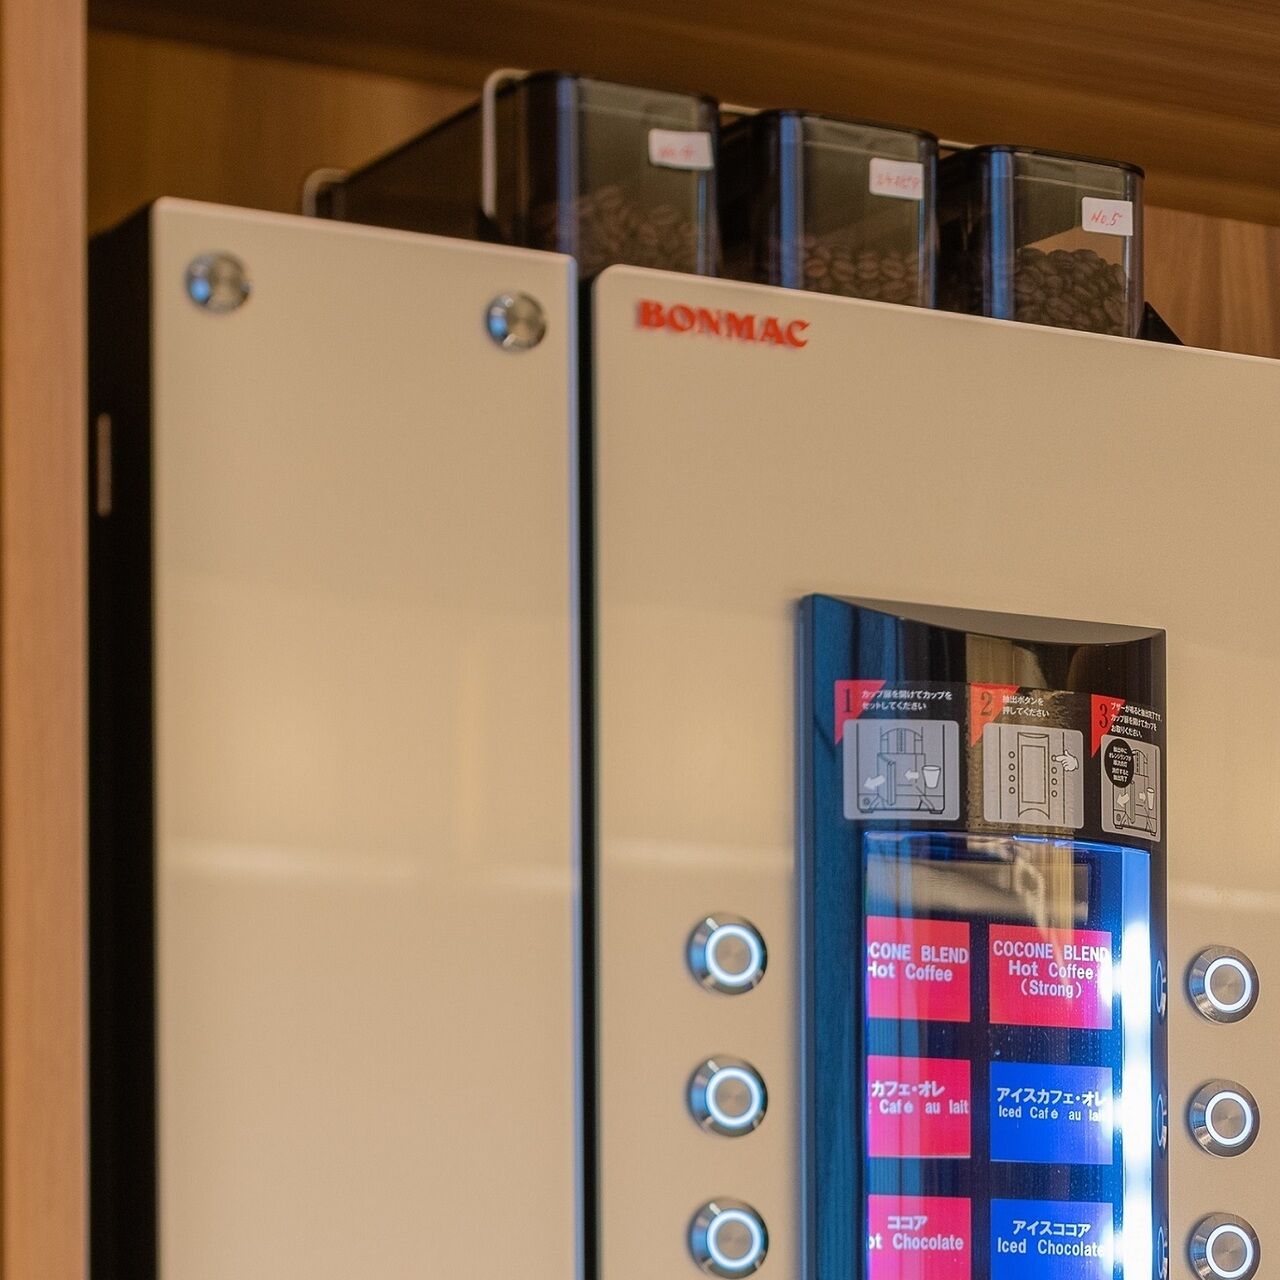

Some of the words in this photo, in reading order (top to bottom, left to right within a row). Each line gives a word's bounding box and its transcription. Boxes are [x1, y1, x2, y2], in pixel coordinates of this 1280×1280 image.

[636, 300, 810, 347] BONMAC
[980, 691, 992, 716] 2
[1099, 704, 1108, 728] 3
[921, 945, 969, 963] BLEND
[993, 941, 1053, 958] COCONE
[1063, 944, 1109, 964] BLEND
[905, 963, 952, 981] Coffee
[1009, 960, 1038, 976] Hot
[1049, 962, 1093, 979] Coffee
[871, 1081, 945, 1097] カフェ・オレ
[925, 1102, 940, 1114] au
[948, 1100, 968, 1114] lait
[999, 1105, 1021, 1118] Iced
[1069, 1110, 1081, 1121] au
[887, 1216, 928, 1231] ココア
[1013, 1220, 1091, 1238] アイスココア
[893, 1233, 964, 1250] Chocolate
[998, 1237, 1027, 1254] Iced
